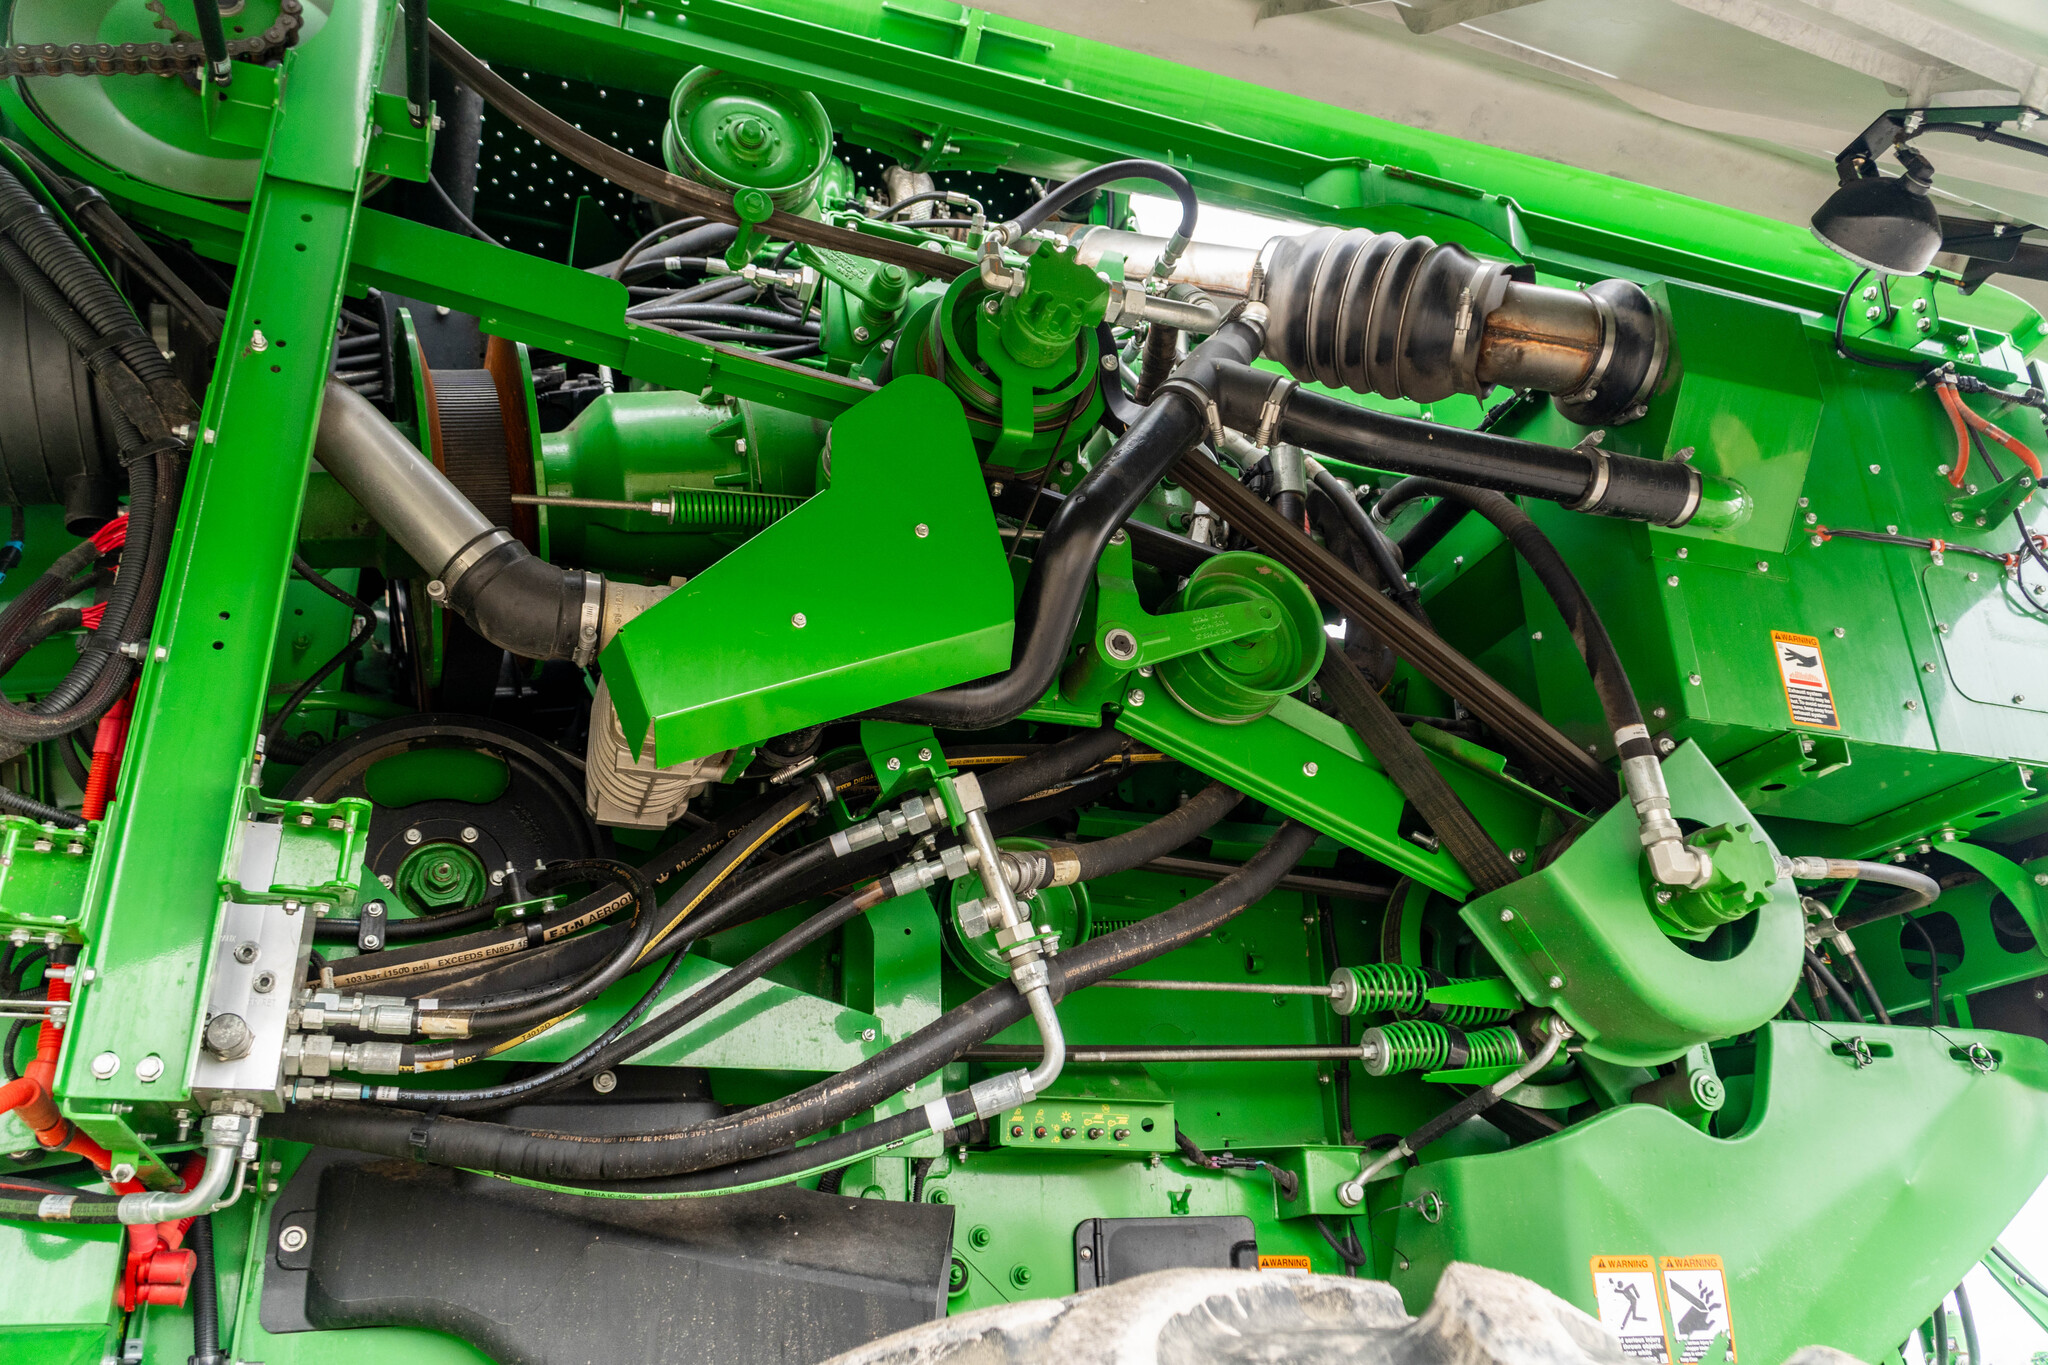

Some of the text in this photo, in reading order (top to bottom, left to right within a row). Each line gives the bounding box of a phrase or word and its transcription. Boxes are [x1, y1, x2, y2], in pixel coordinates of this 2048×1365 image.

[1781, 634, 1817, 646] WARNING
[1175, 929, 1191, 941] HOSE
[345, 974, 362, 985] 103
[363, 972, 381, 981] bar
[383, 966, 410, 979] (1500
[412, 962, 430, 974] psi)
[437, 950, 484, 968] EXCEEDS
[486, 943, 515, 957] EN857
[521, 1022, 551, 1041] T4012D
[766, 1100, 802, 1120] SUCTION
[743, 1113, 765, 1127] HOSE
[558, 1133, 581, 1142] MADE
[694, 1128, 706, 1137] SAE
[584, 1189, 605, 1198] MSHA
[1270, 1258, 1308, 1267] WARNING
[1607, 1259, 1649, 1269] WARNING
[1674, 1258, 1718, 1268] WARNING
